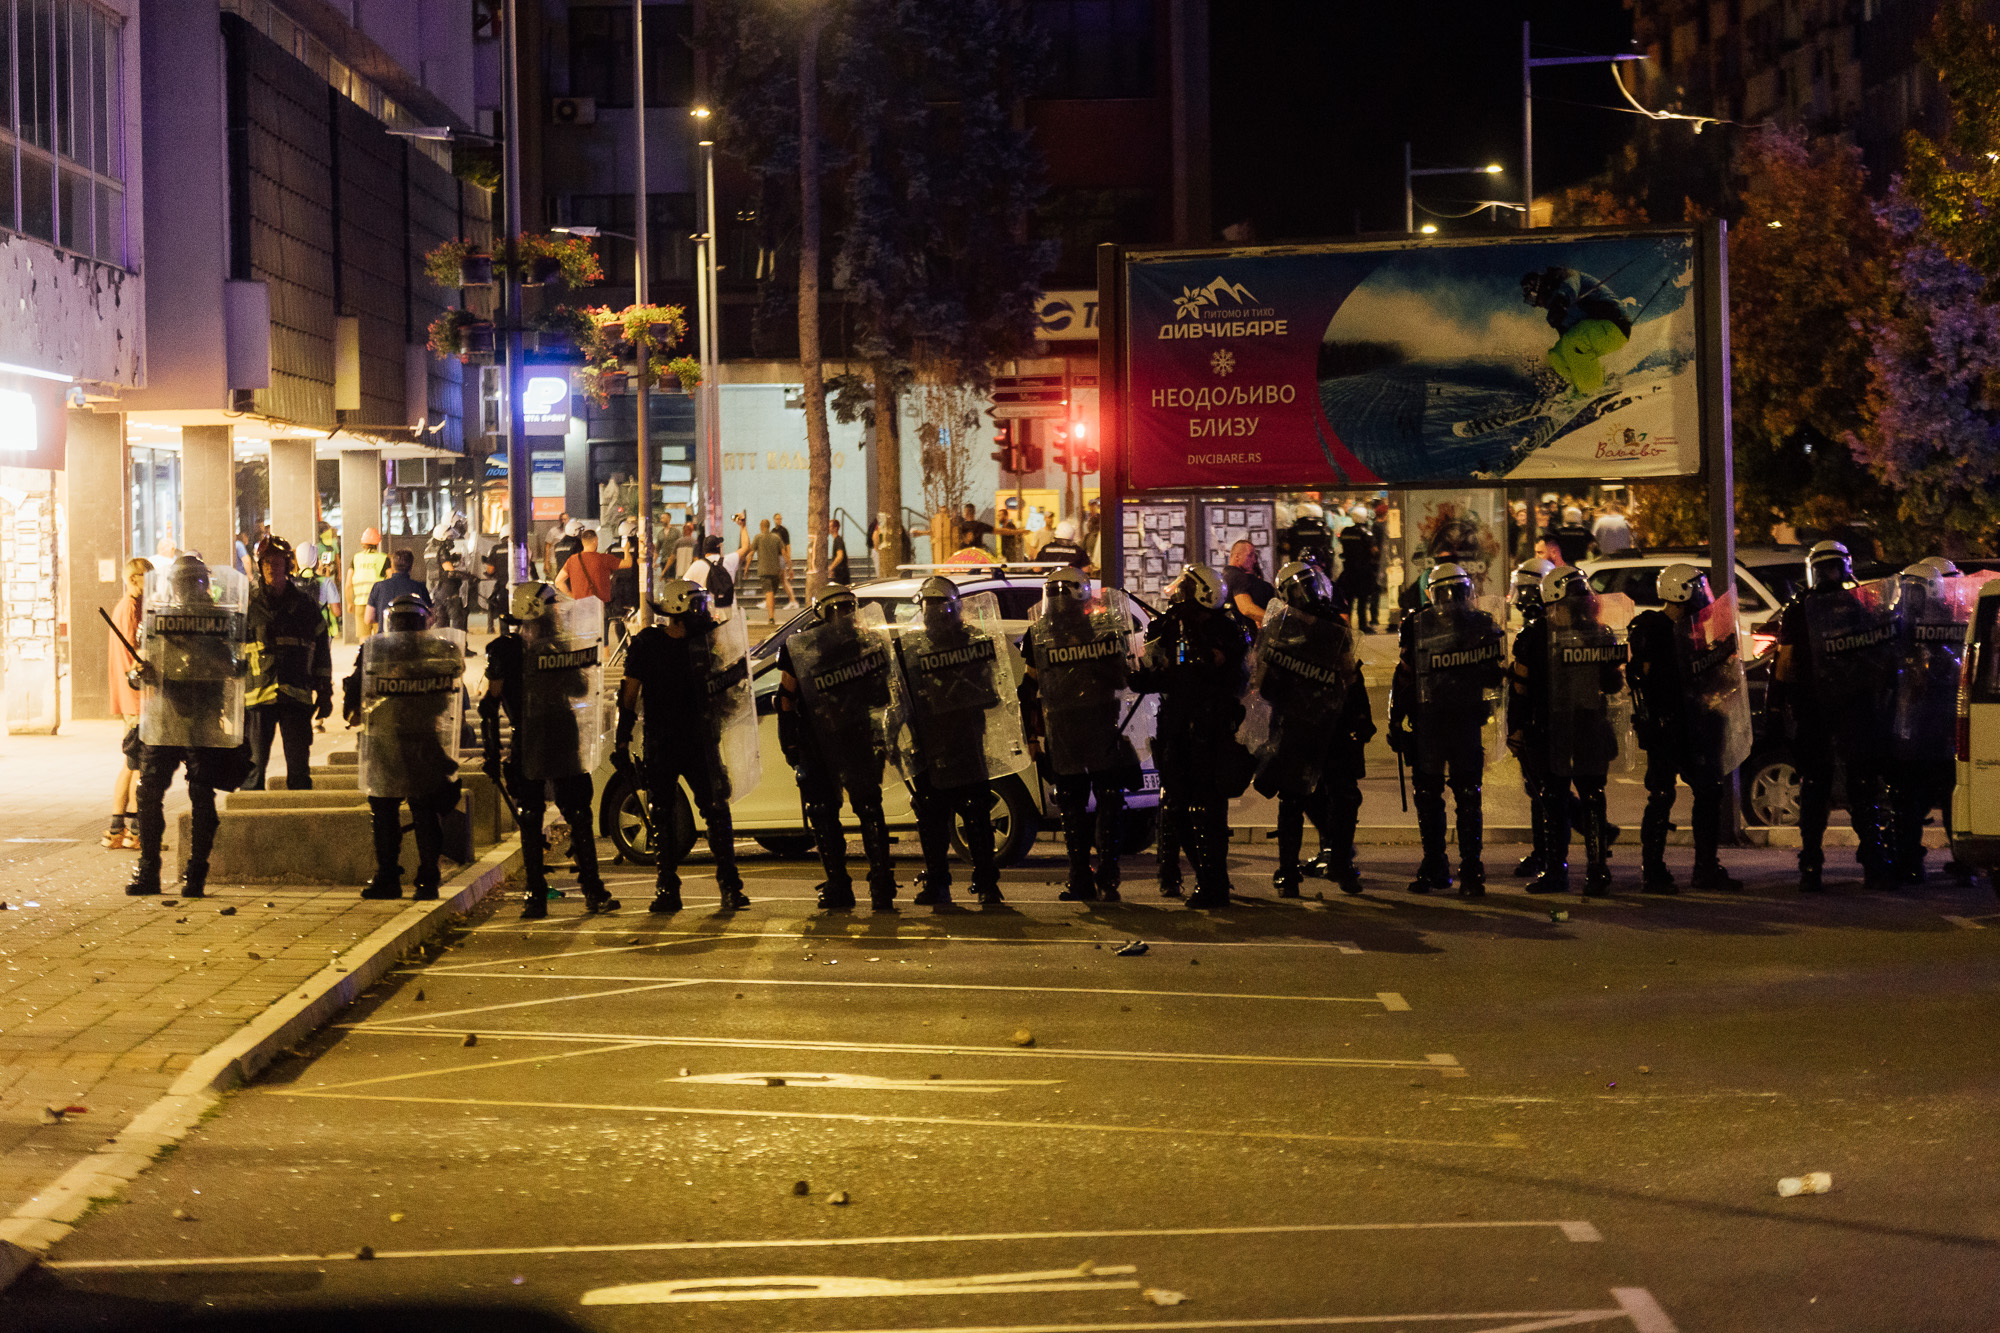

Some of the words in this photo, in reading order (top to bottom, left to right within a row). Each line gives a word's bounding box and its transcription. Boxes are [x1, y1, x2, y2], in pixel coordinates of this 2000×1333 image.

[1204, 310, 1242, 318] ПИТОМО
[1243, 309, 1250, 317] И
[1251, 308, 1275, 317] ТИХО
[1158, 320, 1288, 340] ДИВЧИБАРЕ
[1152, 384, 1296, 411] НЕОДОЉИВО
[1190, 417, 1260, 437] БЛИЗУ
[724, 452, 757, 471] ПТТ
[1187, 453, 1262, 465] DIVCIBARE.RS
[1824, 624, 1897, 652] ПОЛИЦИЈА
[920, 643, 995, 670] ПОЛИЦИЈА
[1048, 640, 1120, 663] ПОЛИЦИЈА
[1432, 645, 1498, 668] ПОЛИЦИЈА
[1563, 647, 1628, 663] ПОЛИЦИЈА
[814, 652, 885, 690] ПОЛИЦИЈА
[1266, 648, 1335, 684] ПОЛИЦИЈА
[377, 676, 452, 694] ПОЛИЦИЈА
